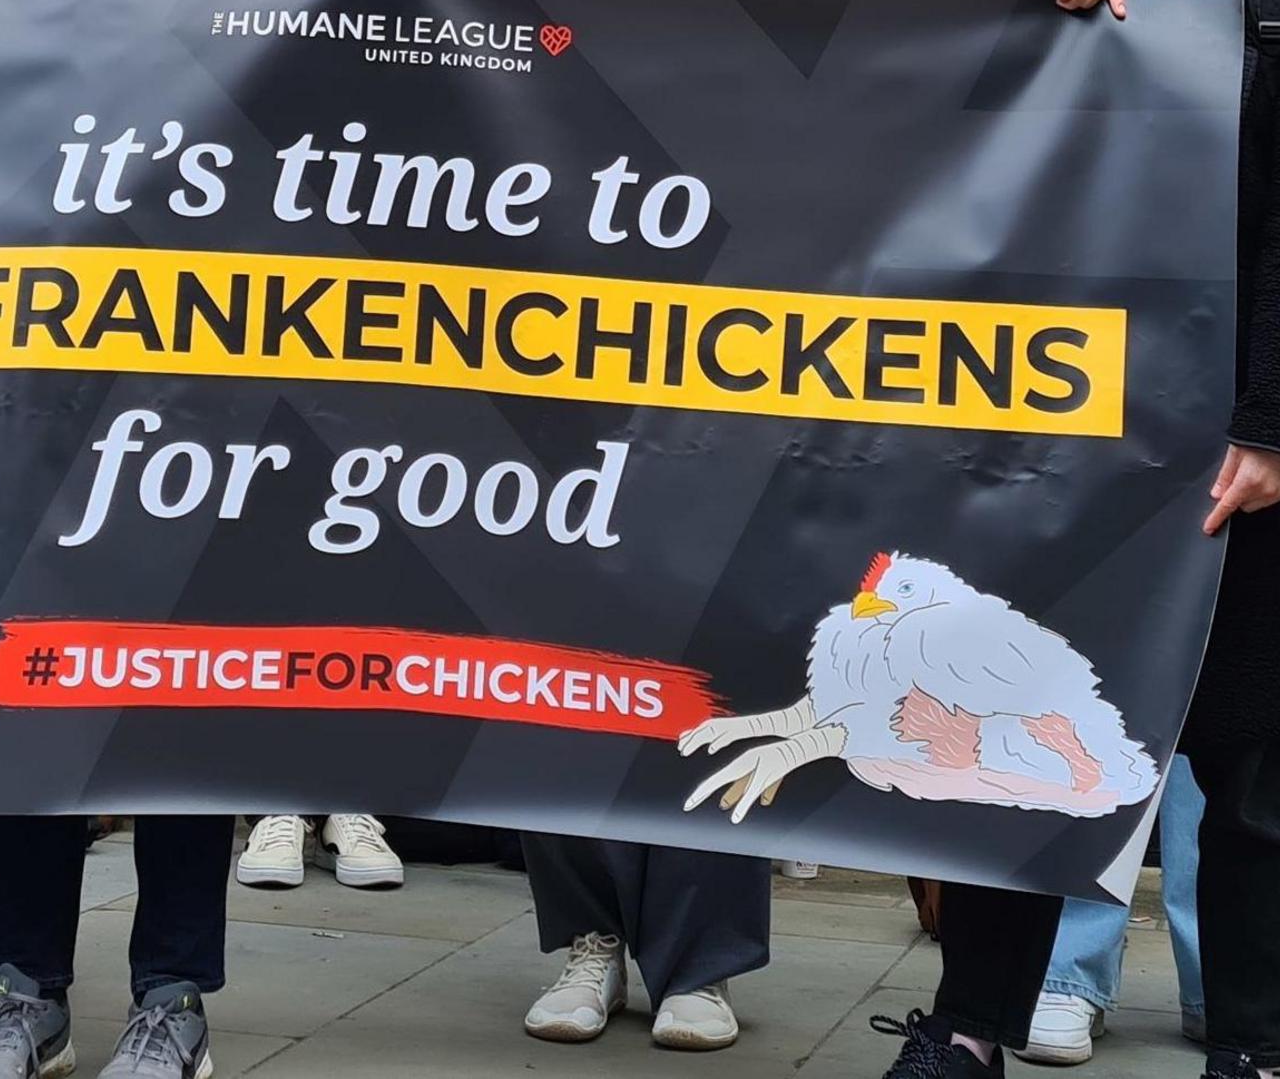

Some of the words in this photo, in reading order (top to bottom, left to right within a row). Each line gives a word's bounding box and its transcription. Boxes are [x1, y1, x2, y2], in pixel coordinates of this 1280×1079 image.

[211, 11, 224, 36] THE
[226, 10, 386, 41] HUMANE
[395, 16, 534, 52] LEAGUE
[365, 48, 433, 65] UNITED
[440, 53, 532, 72] KINGDOM
[272, 121, 552, 238] time
[588, 155, 712, 250] to
[58, 409, 290, 547] for
[307, 440, 629, 555] good
[21, 646, 664, 719] #JUSTICEFORCHICKENS
